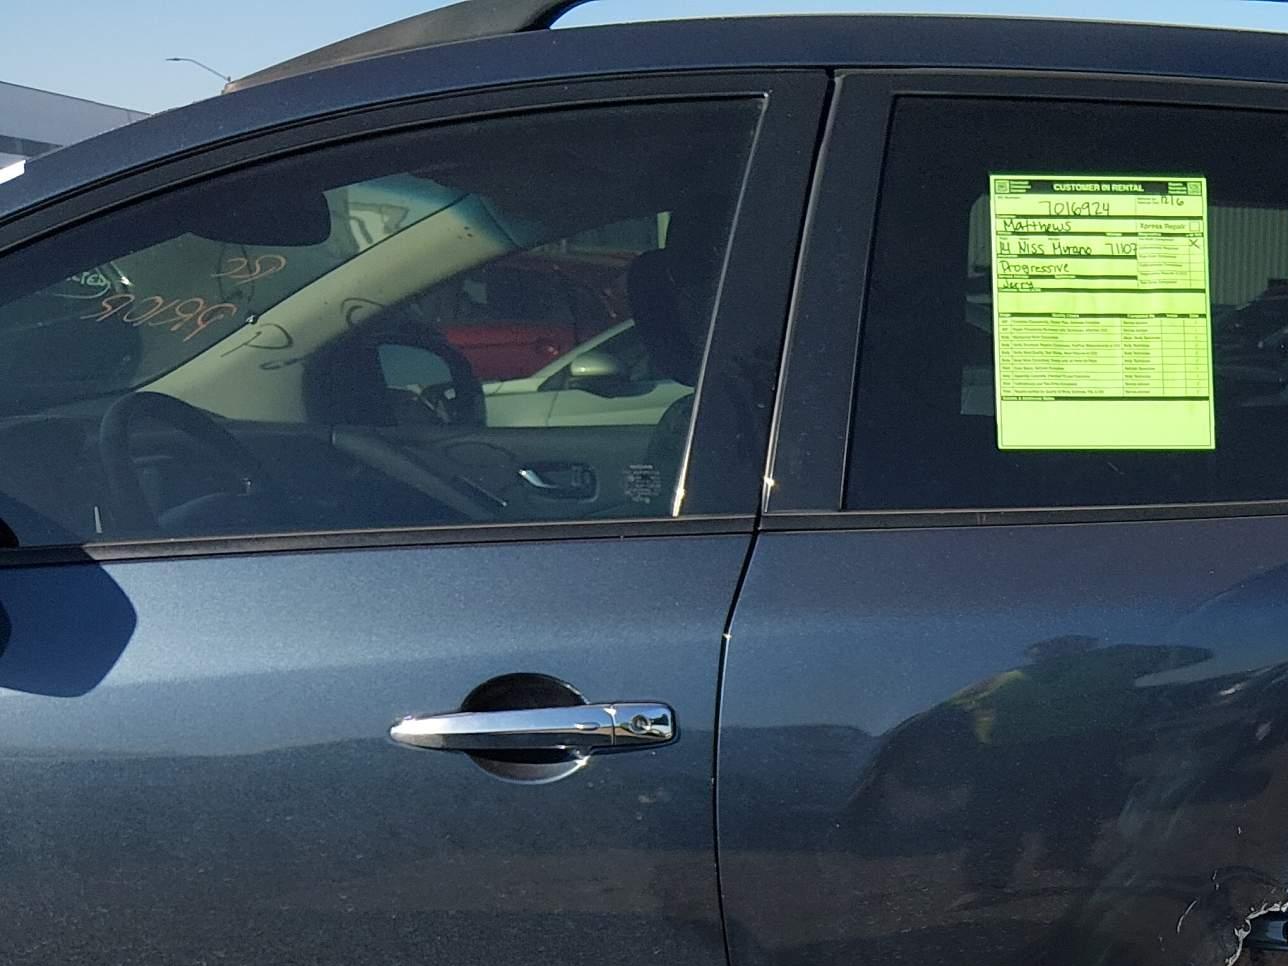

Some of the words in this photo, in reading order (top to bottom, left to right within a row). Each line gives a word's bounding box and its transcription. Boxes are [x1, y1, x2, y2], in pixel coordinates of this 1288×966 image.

[1053, 183, 1100, 192] CUSTOMER
[1112, 184, 1145, 192] RENTAL
[1038, 200, 1110, 216] 7016924
[1003, 219, 1072, 233] Matthews
[999, 260, 1070, 274] Progressive
